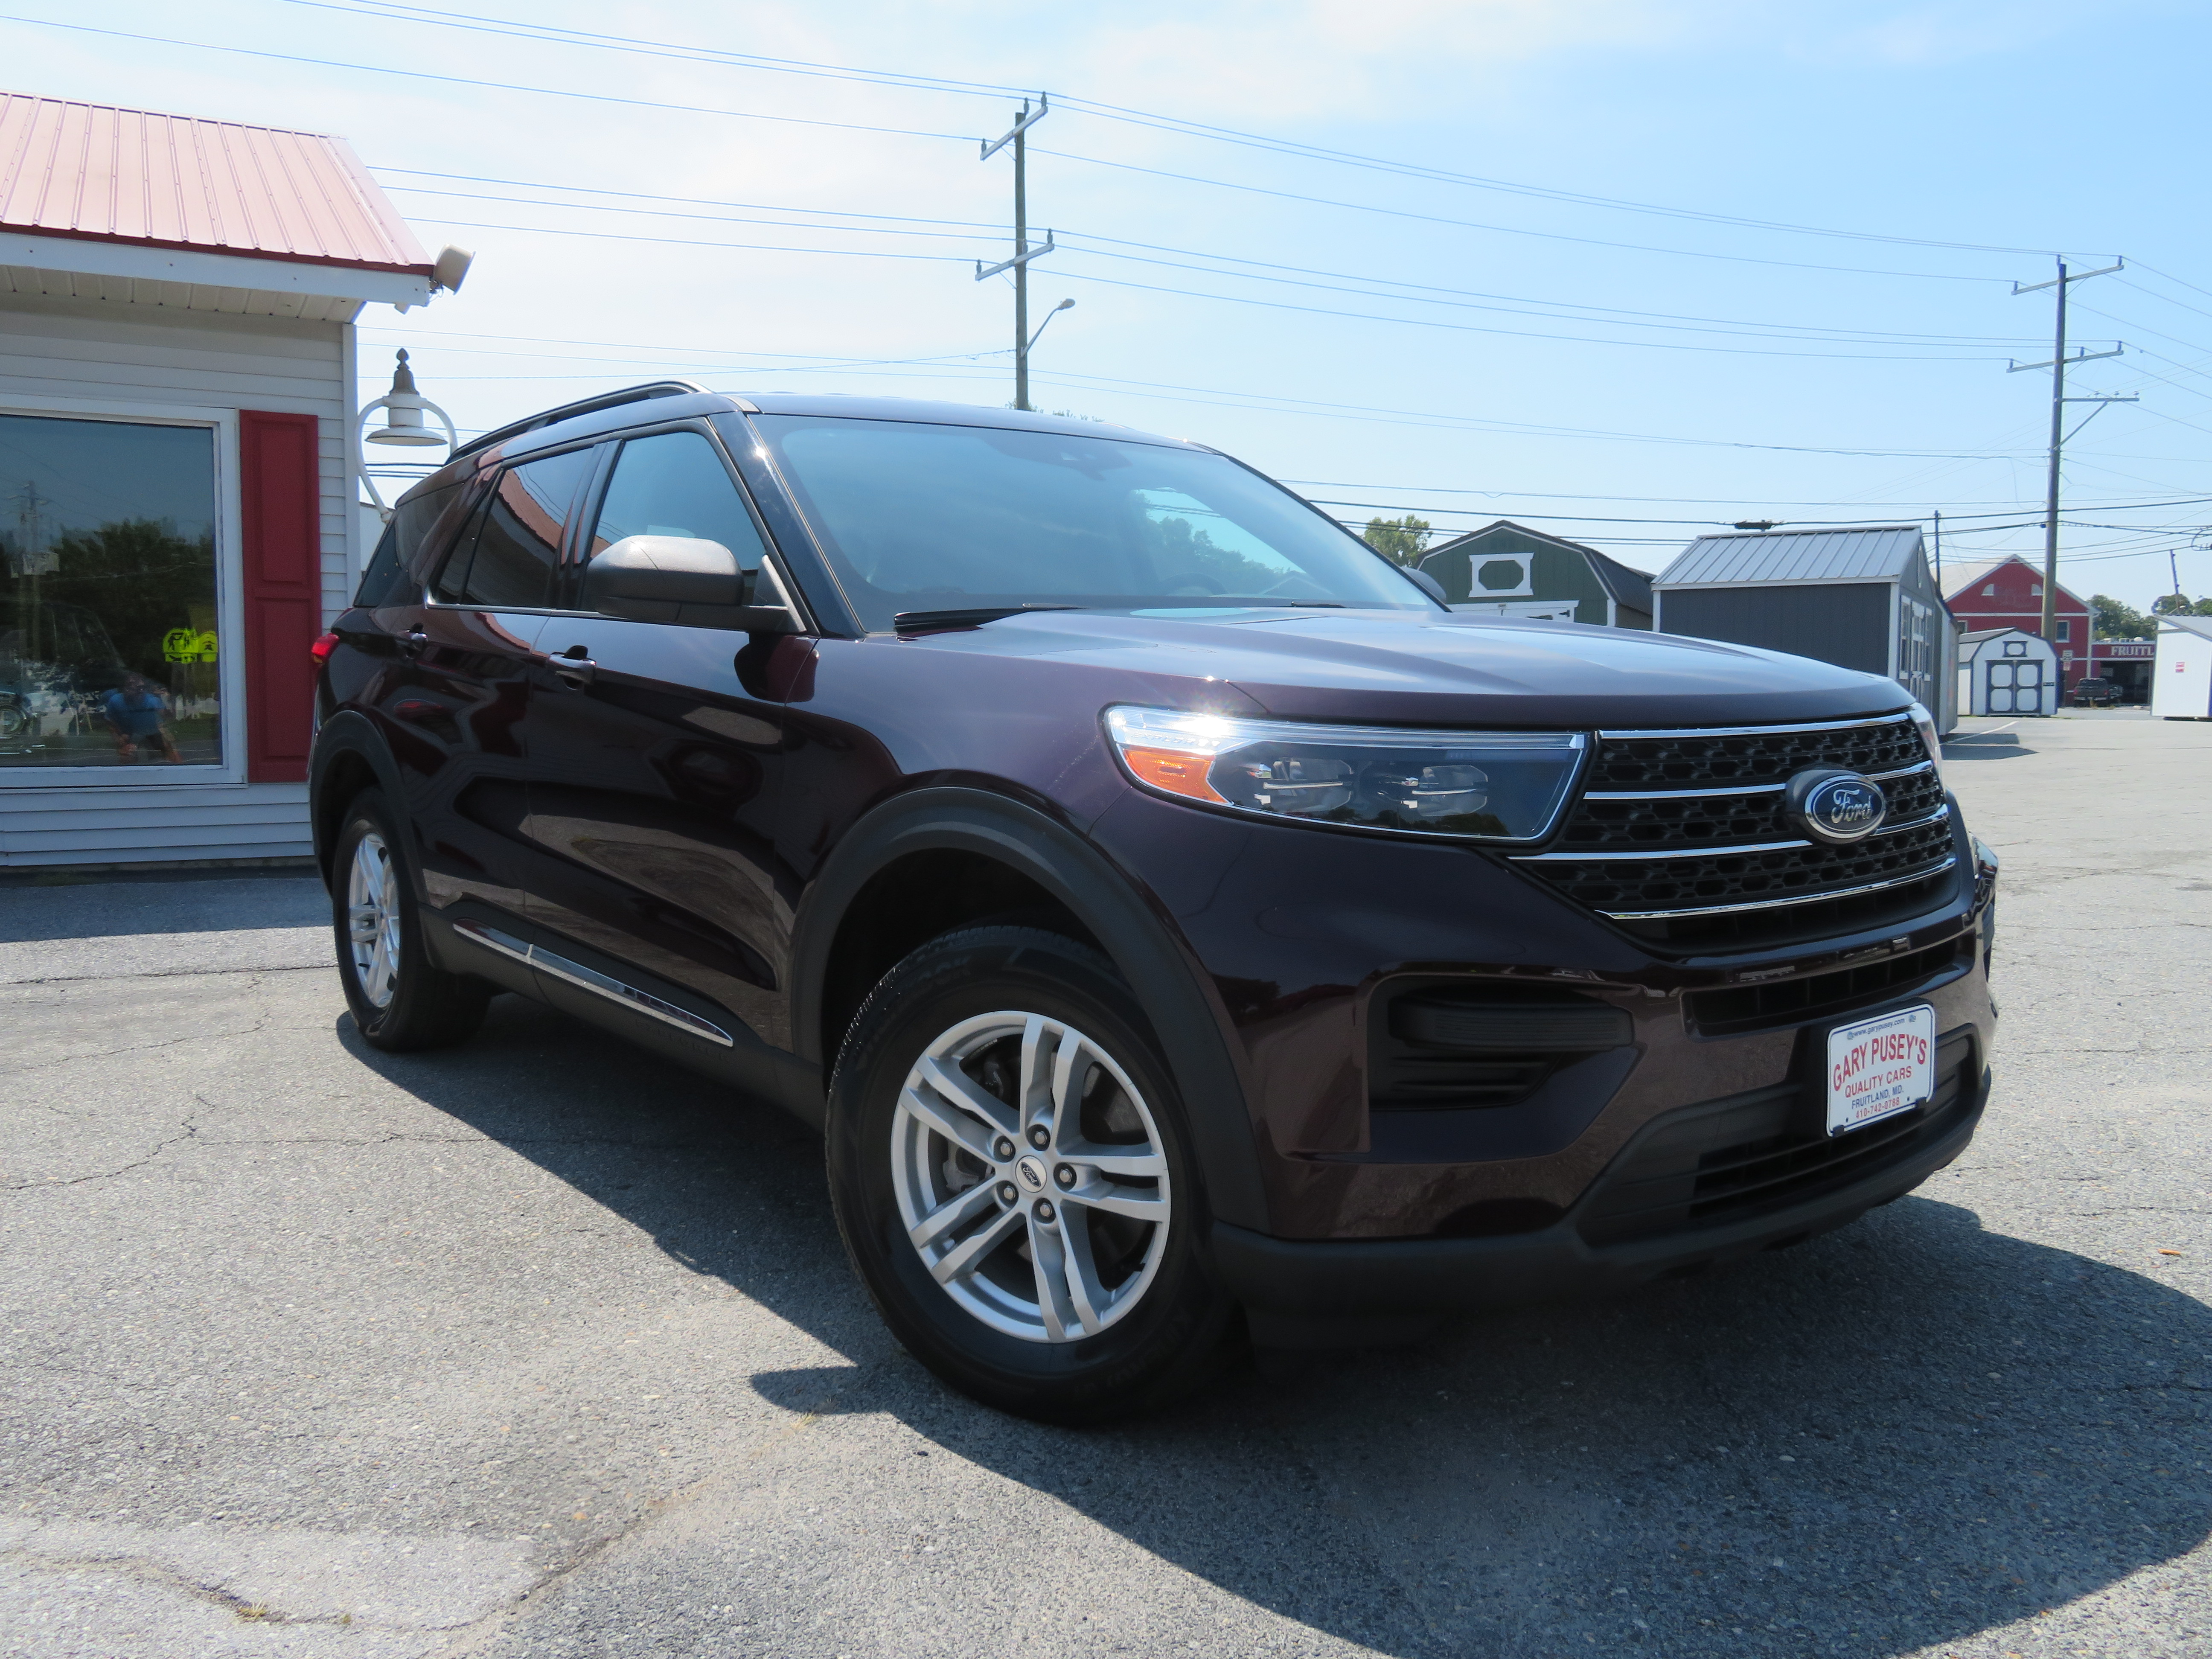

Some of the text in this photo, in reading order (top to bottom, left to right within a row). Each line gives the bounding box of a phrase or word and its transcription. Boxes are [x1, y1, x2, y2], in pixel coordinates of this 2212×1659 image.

[1831, 789, 1873, 824] Ford
[1833, 1033, 1927, 1091] GARY PUSEY'S
[1845, 1065, 1912, 1098] QUALITY CARS
[1851, 1085, 1904, 1109] FRUITLAND, MD.
[1856, 1097, 1900, 1118] 410-742-0788
[1023, 1167, 1037, 1183] Ford
